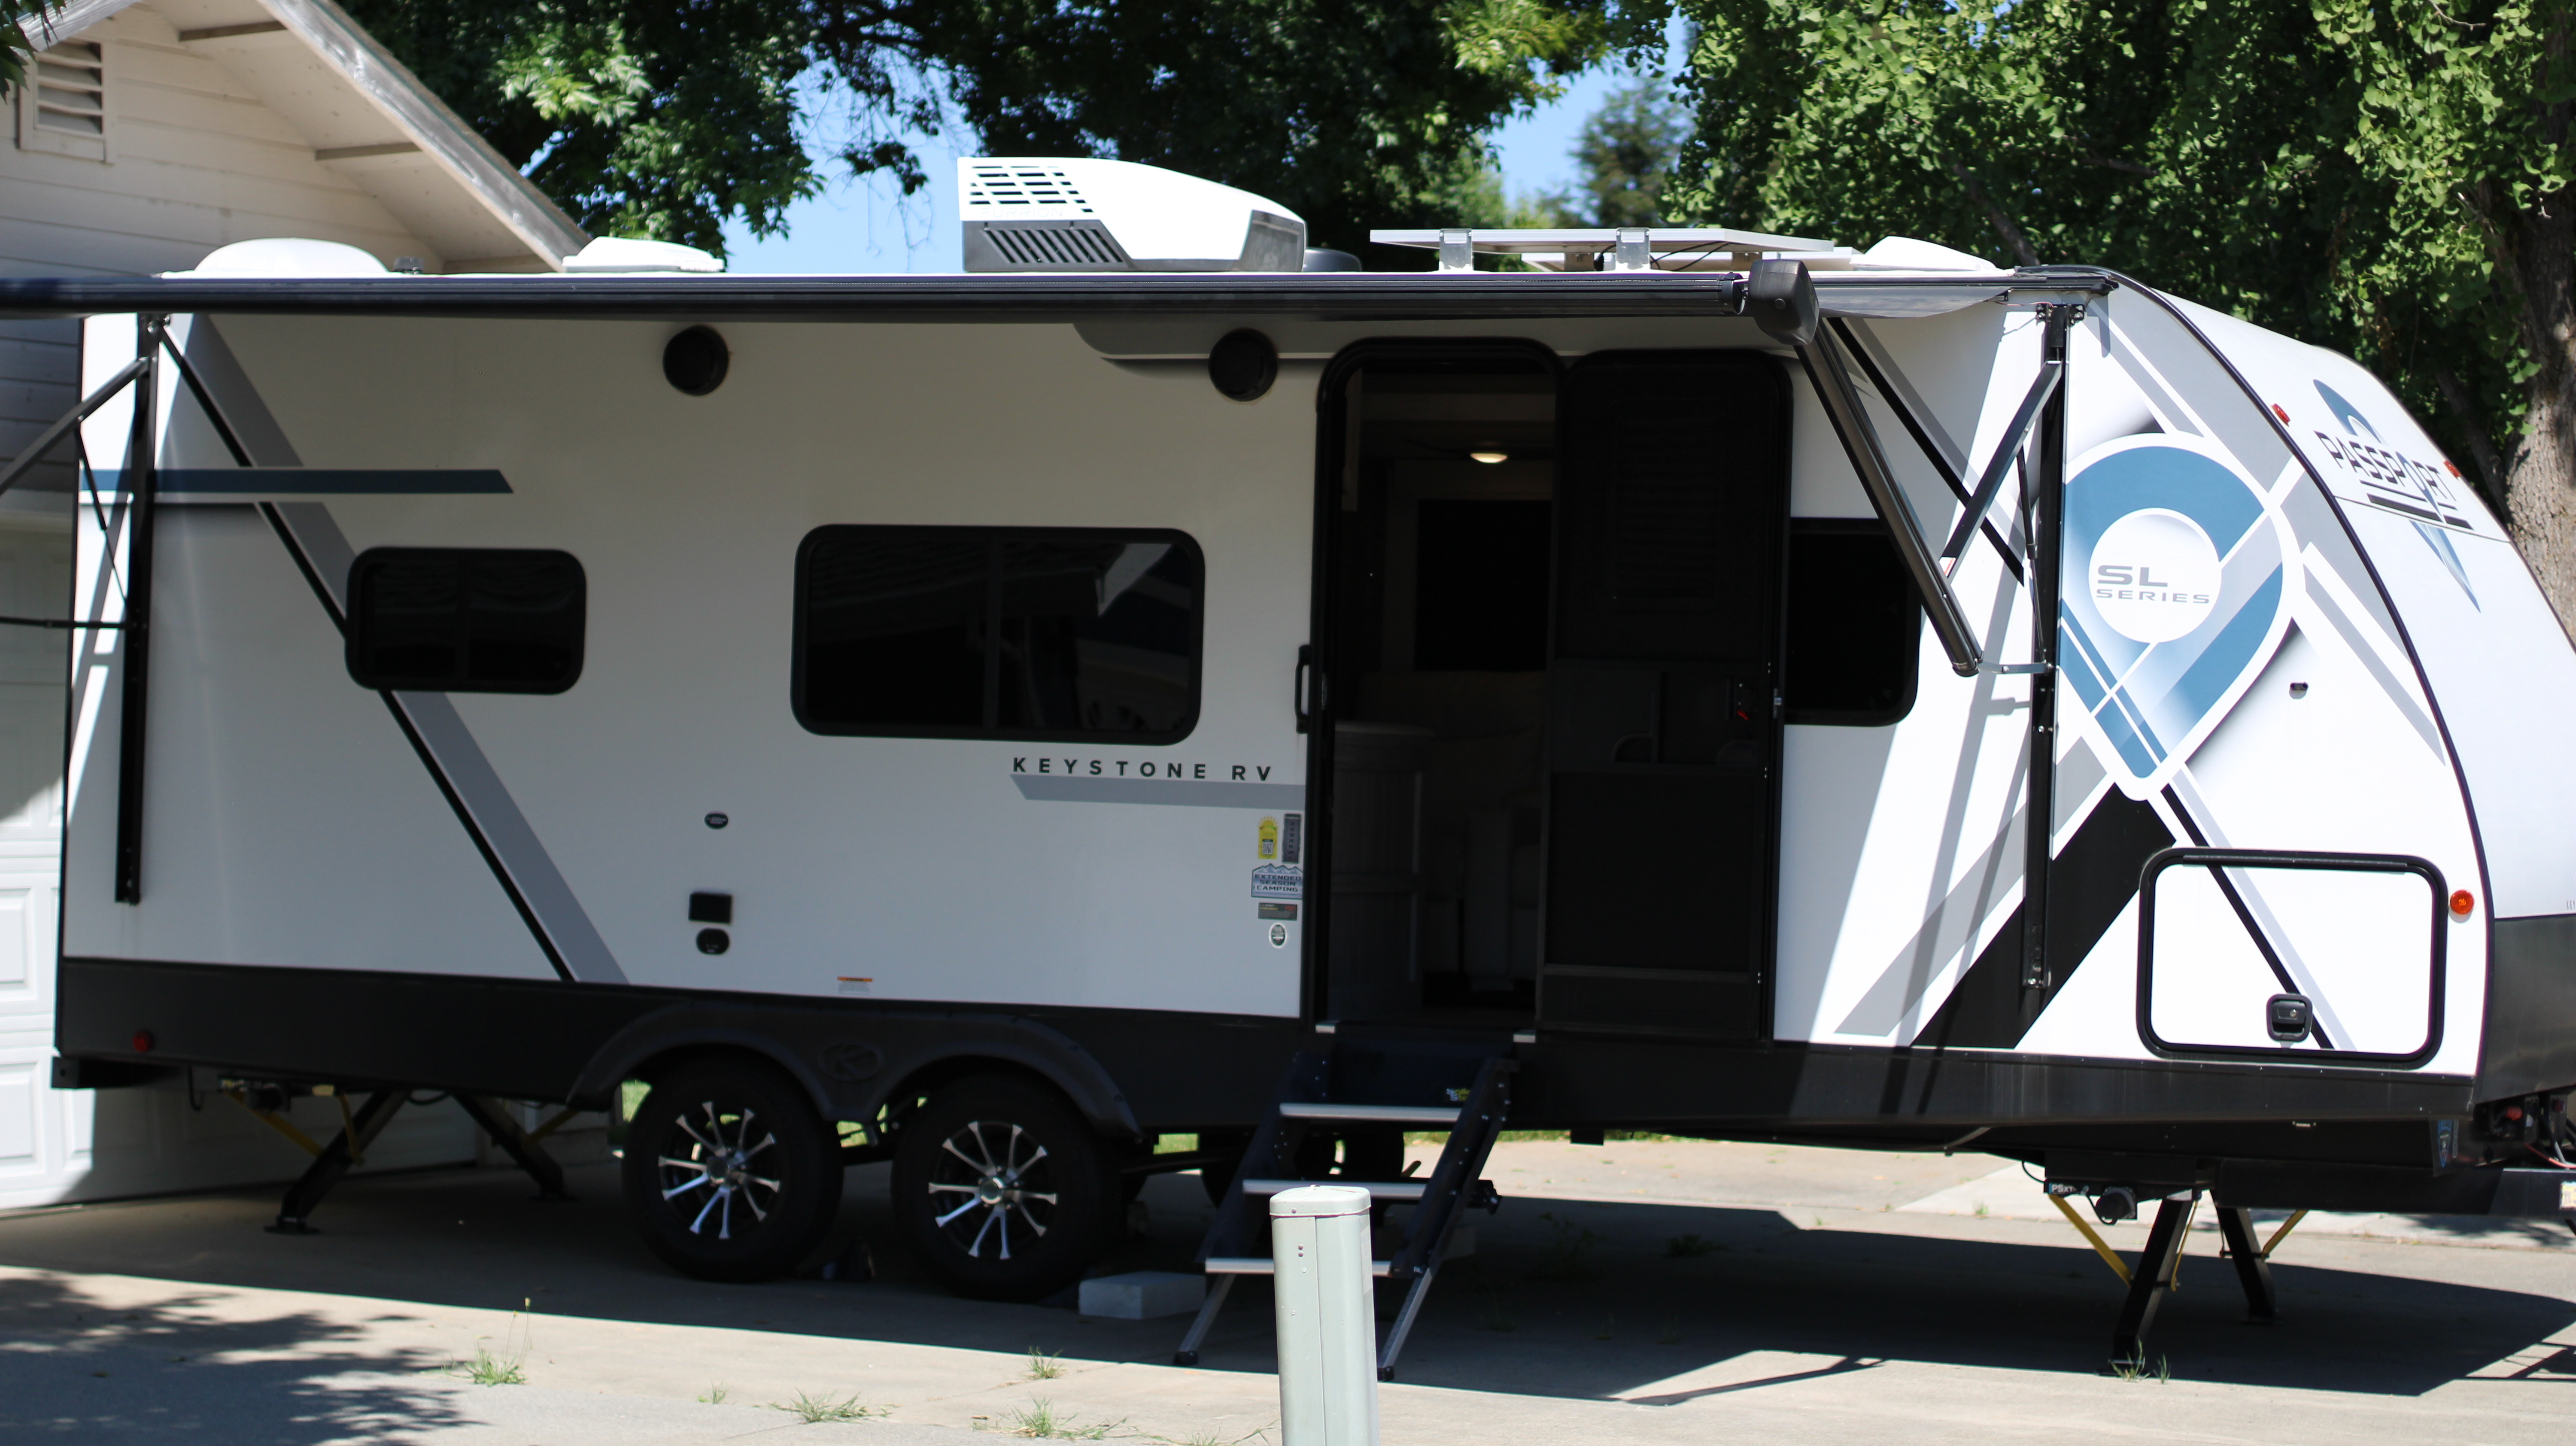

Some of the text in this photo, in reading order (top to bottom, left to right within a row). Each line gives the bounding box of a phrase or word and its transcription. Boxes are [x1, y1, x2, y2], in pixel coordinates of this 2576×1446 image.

[981, 208, 1063, 217] FURRION
[2313, 430, 2457, 501] PASSPORT
[2098, 565, 2168, 587] SL
[2096, 589, 2210, 604] SERIES
[1013, 757, 1271, 781] KEYSTONE RV
